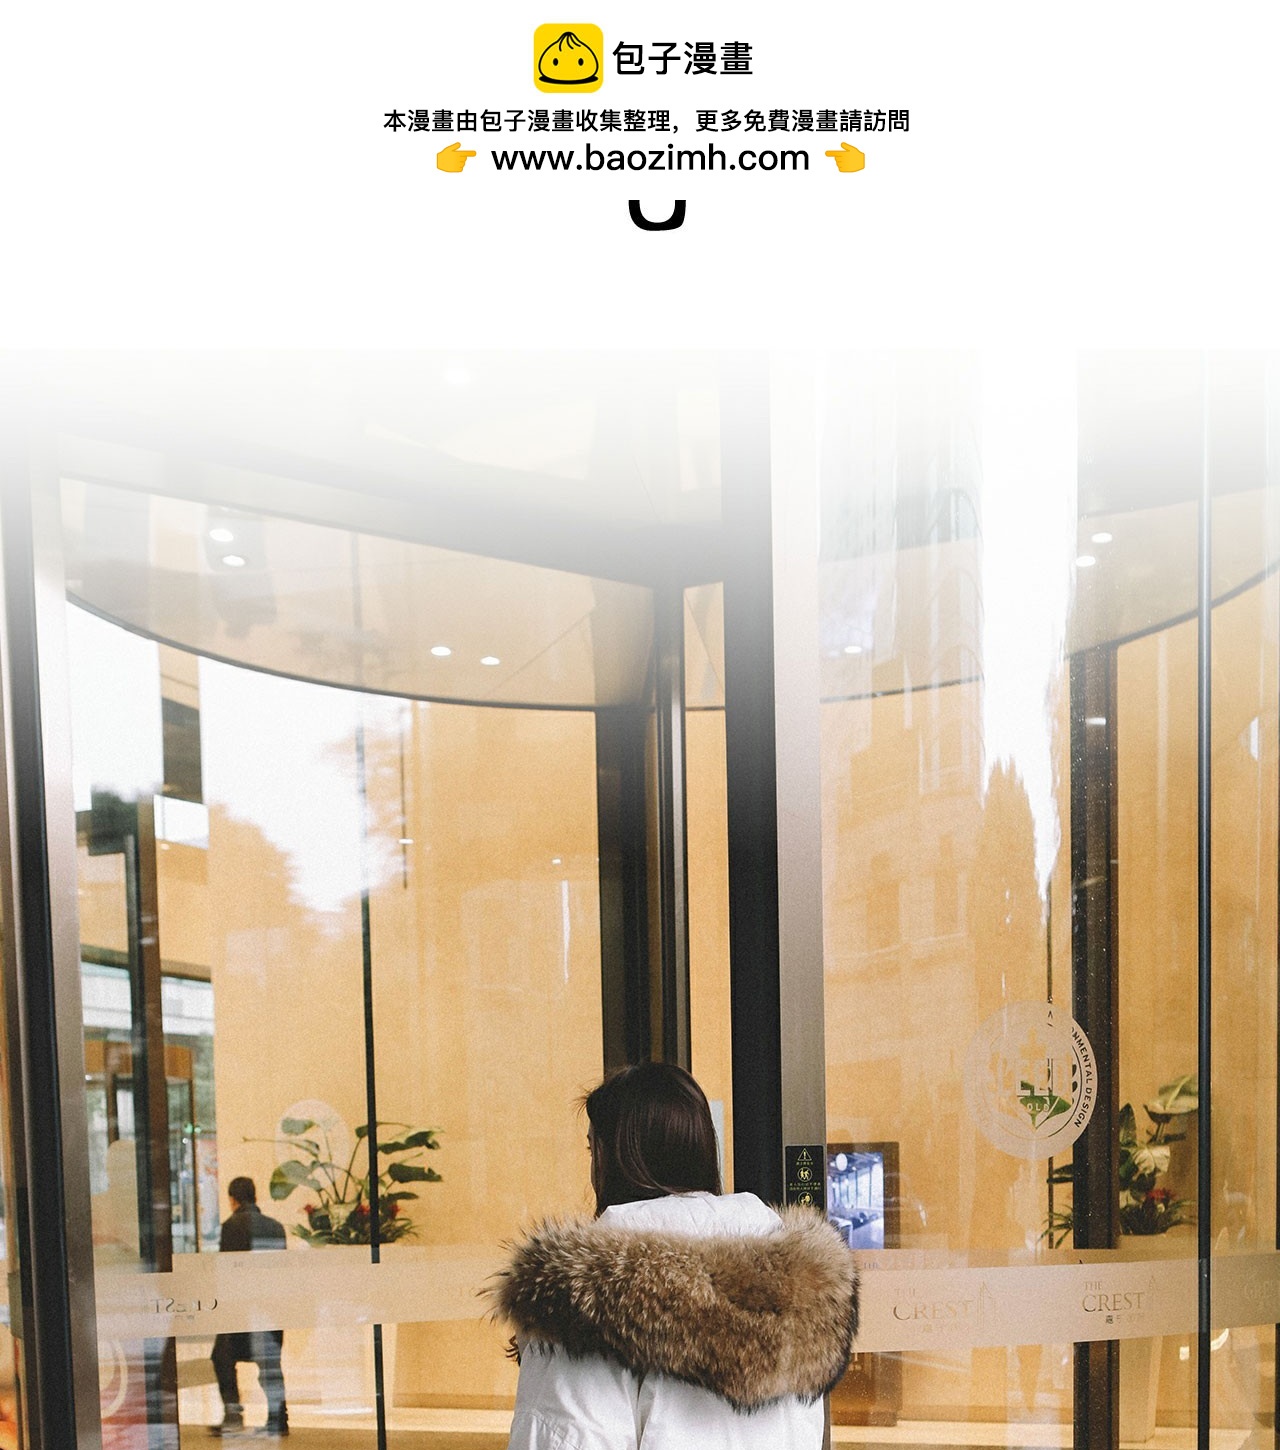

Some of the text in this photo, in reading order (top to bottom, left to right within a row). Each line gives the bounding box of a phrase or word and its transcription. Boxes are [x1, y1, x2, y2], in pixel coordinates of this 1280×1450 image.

[1074, 1087, 1093, 1128] DESIGN
[892, 1299, 974, 1321] CREST
[1082, 1291, 1145, 1313] CREST
